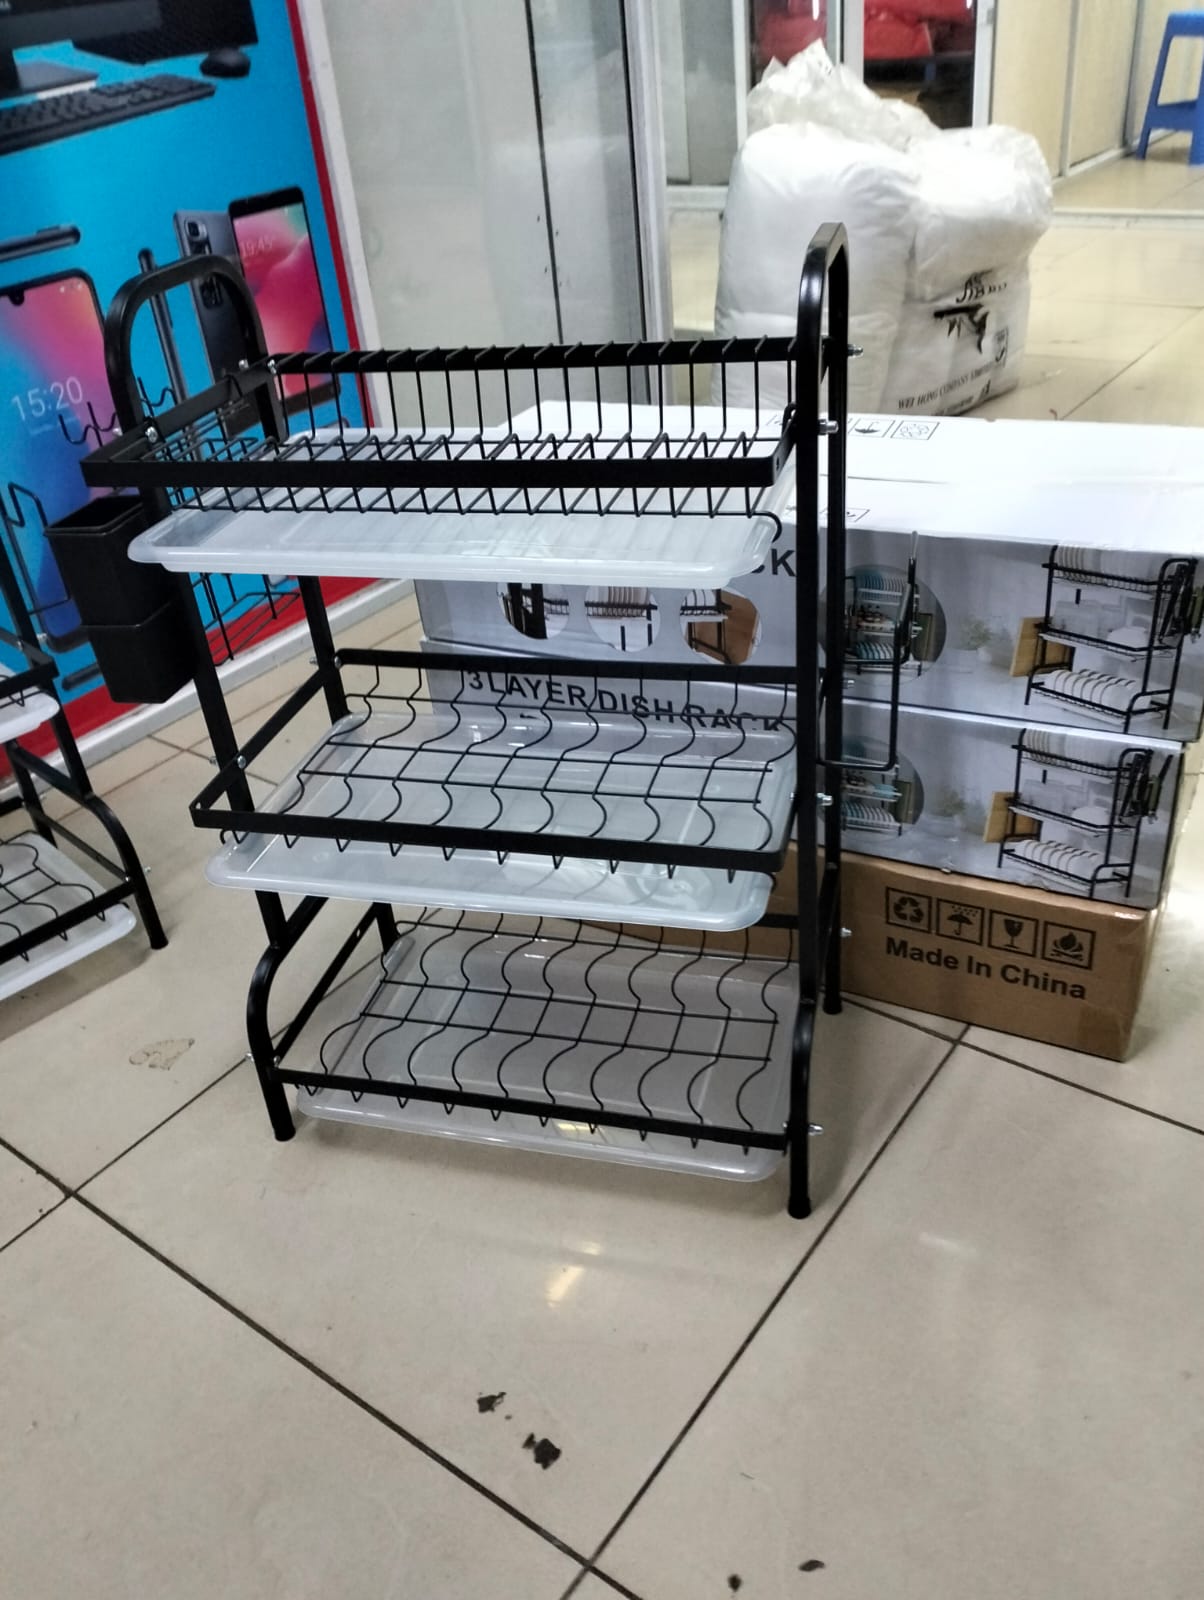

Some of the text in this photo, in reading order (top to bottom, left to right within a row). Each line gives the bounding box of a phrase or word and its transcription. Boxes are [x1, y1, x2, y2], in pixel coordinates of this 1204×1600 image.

[11, 376, 83, 421] 15:20
[466, 670, 483, 690] 3
[487, 672, 588, 708] LAYER
[597, 689, 675, 723] DISH
[886, 936, 1086, 999] Made In China
